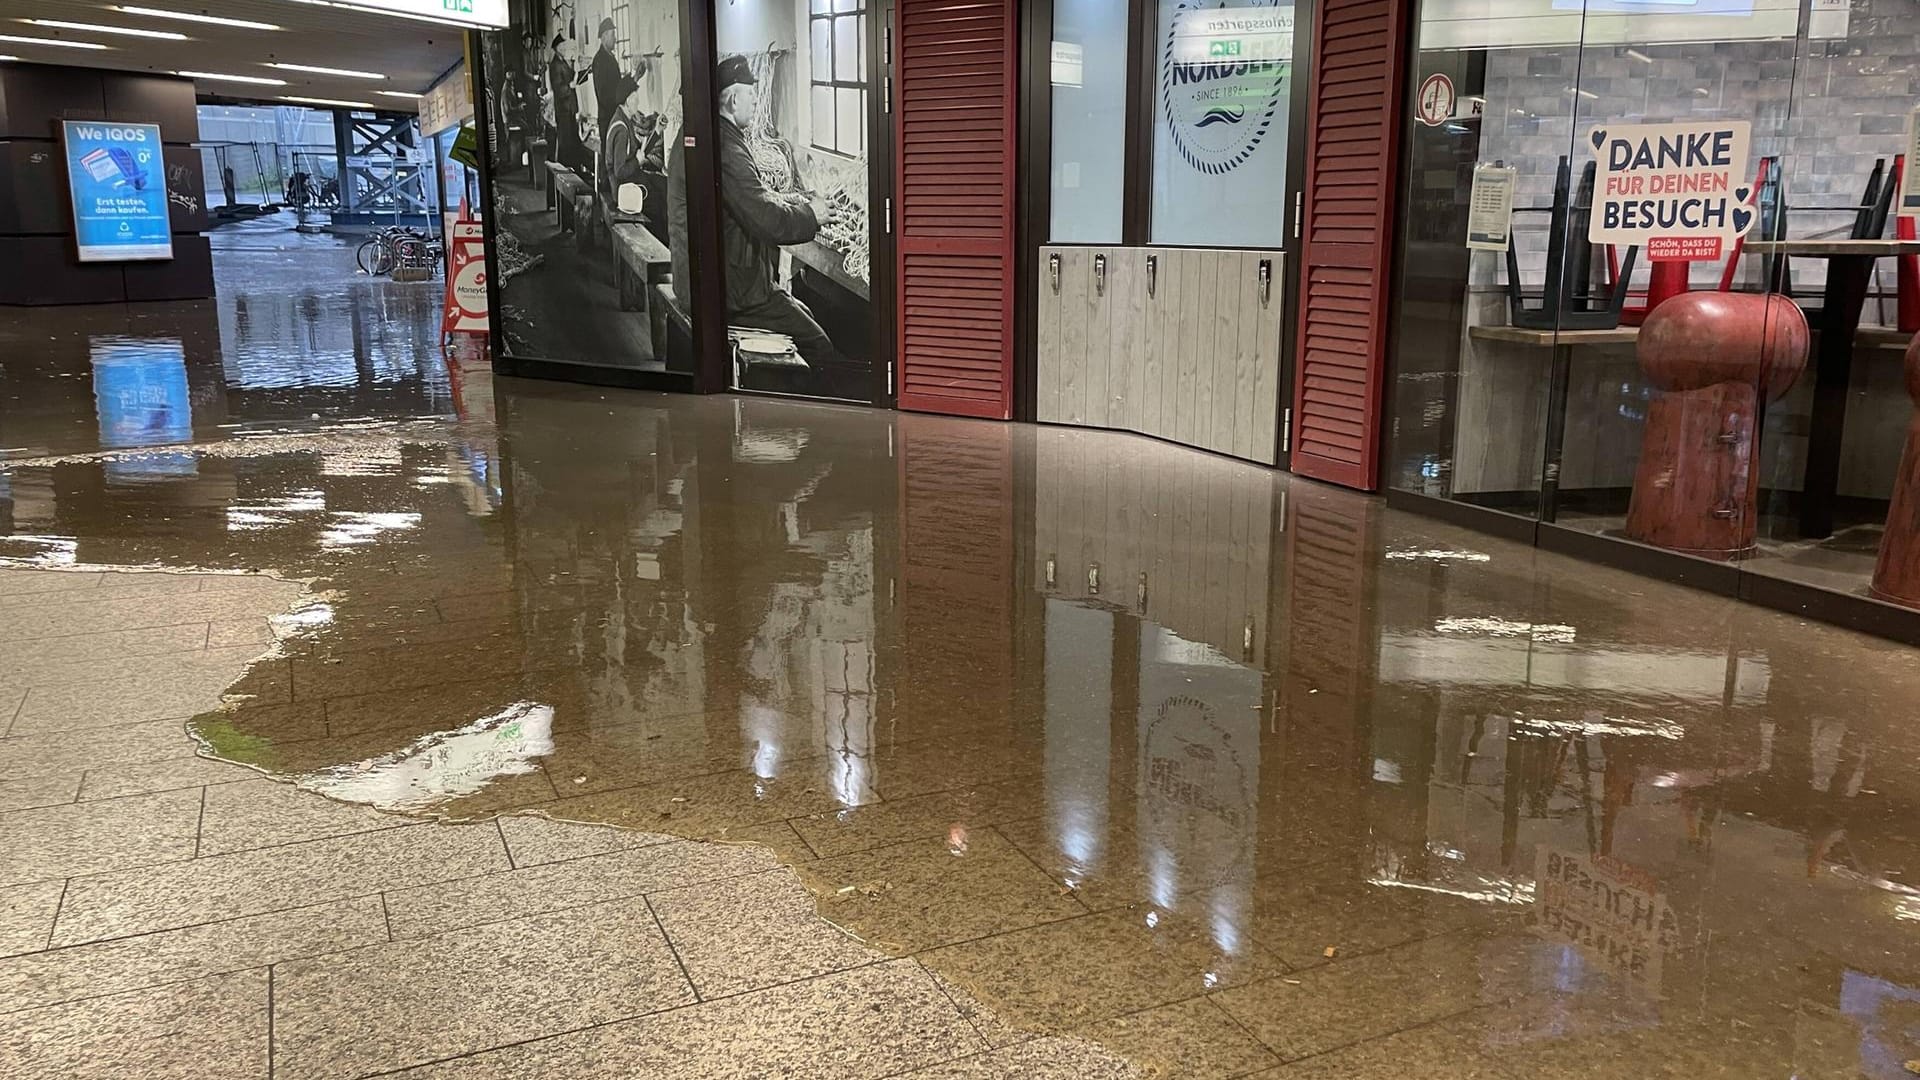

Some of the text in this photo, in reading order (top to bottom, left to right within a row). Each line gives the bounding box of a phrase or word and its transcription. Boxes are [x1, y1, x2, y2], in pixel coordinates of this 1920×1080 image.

[1196, 86, 1243, 101] SINCE 1896
[76, 126, 146, 142] We IQOS
[1608, 130, 1734, 171] DANKE
[1606, 169, 1729, 196] FÜR DEINEN
[96, 198, 115, 206] Erst
[1603, 198, 1727, 229] BESUCH
[1650, 239, 1717, 249] SCHÖN, DASS DU
[1649, 247, 1716, 257] WIEDER DA BIST!
[457, 286, 488, 297] MoneyG
